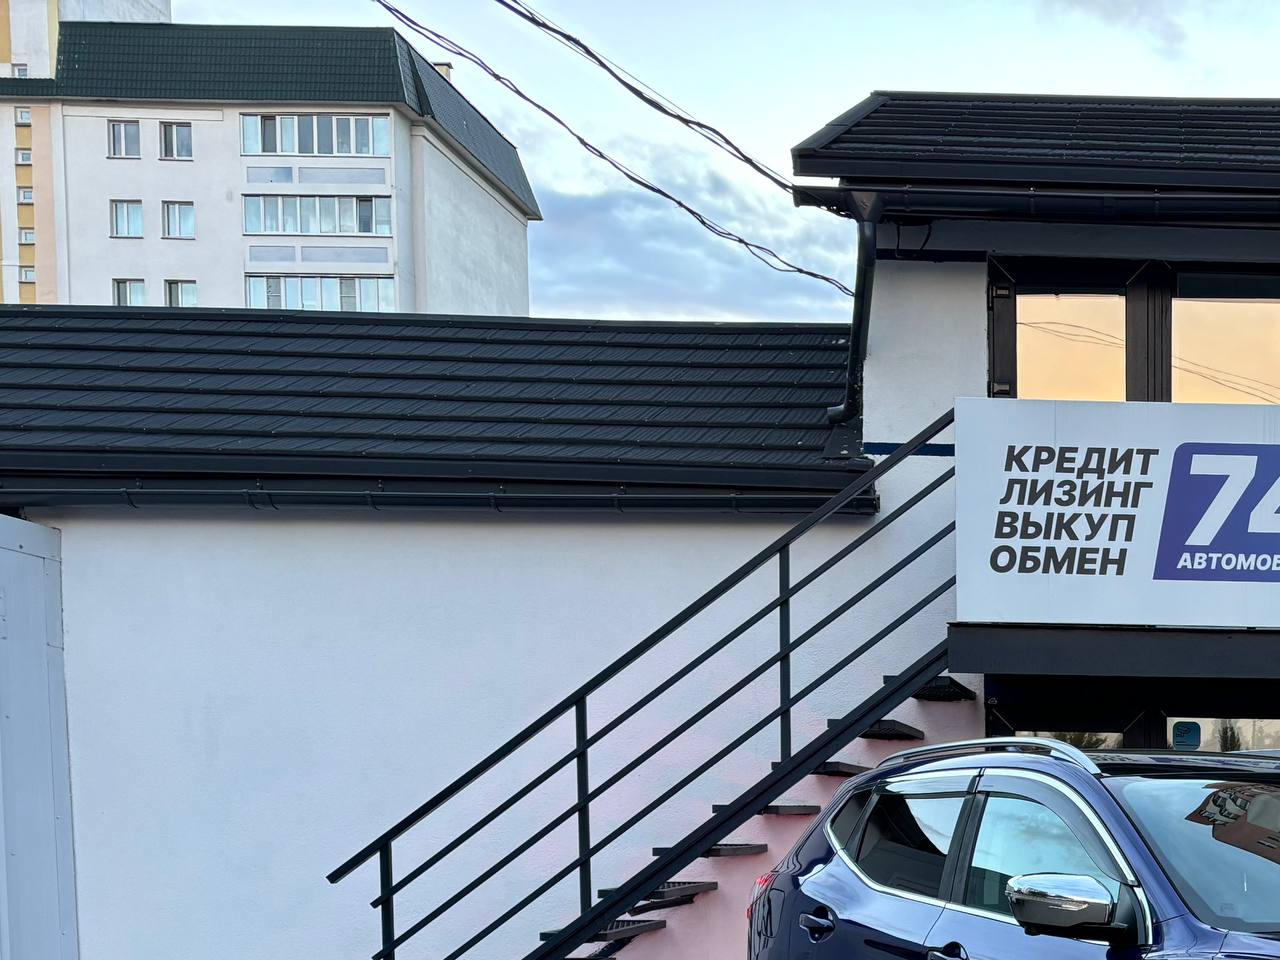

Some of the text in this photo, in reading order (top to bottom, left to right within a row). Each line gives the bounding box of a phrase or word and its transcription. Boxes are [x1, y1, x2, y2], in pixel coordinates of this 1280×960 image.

[1003, 444, 1160, 478] КРЕДИТ
[999, 477, 1154, 509] ЛИЗИНГ
[994, 510, 1137, 543] ВЫКУП
[988, 544, 1128, 577] ОБМЕН
